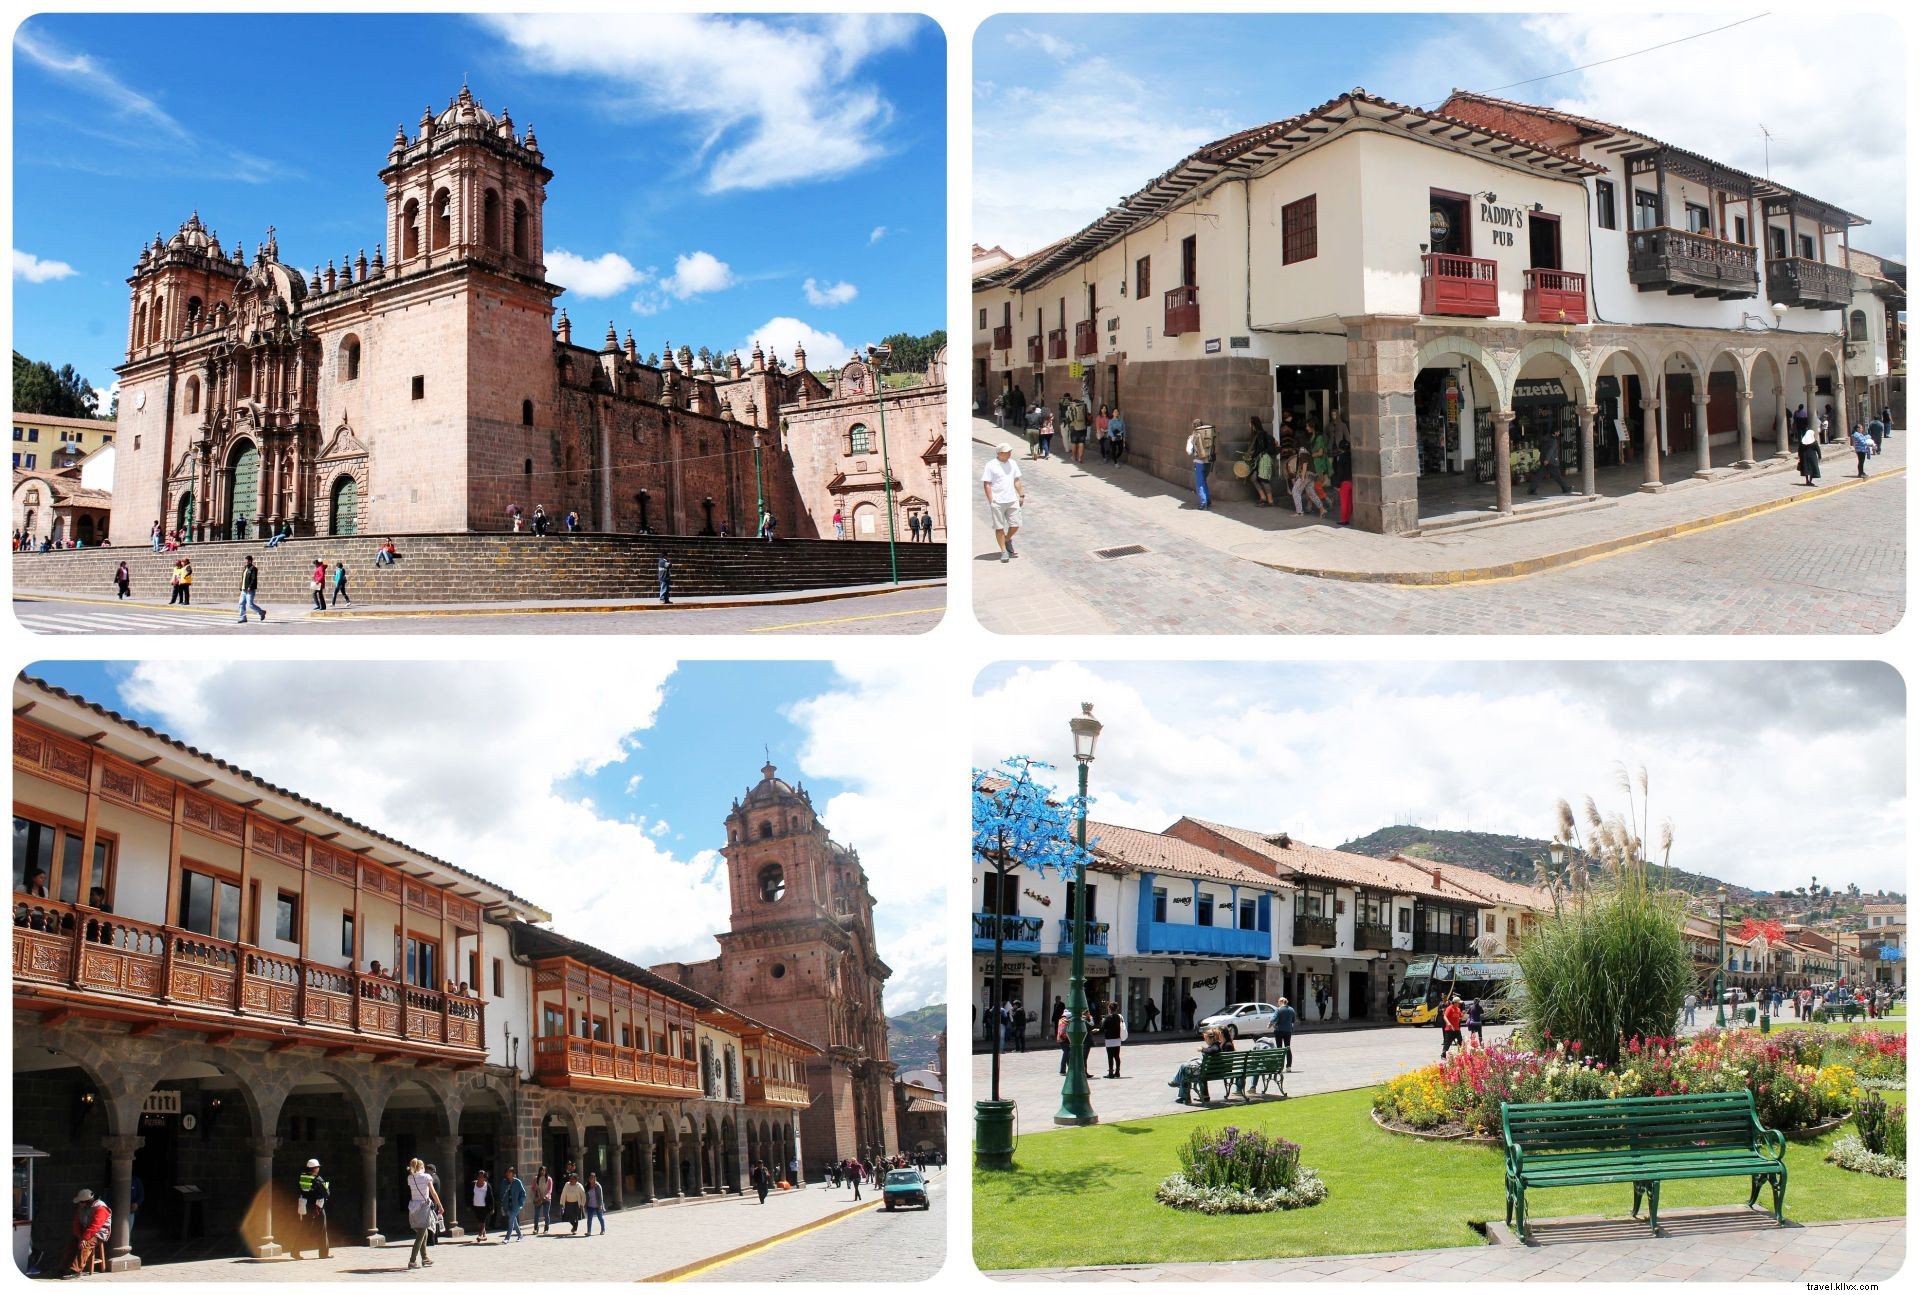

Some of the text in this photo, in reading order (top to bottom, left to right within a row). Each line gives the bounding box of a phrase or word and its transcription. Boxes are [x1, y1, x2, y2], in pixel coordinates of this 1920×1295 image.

[1481, 203, 1522, 228] PADDY'S
[1492, 230, 1513, 246] PUB
[1219, 902, 1233, 911] BEMBO
[1192, 976, 1219, 991] BEMBOS
